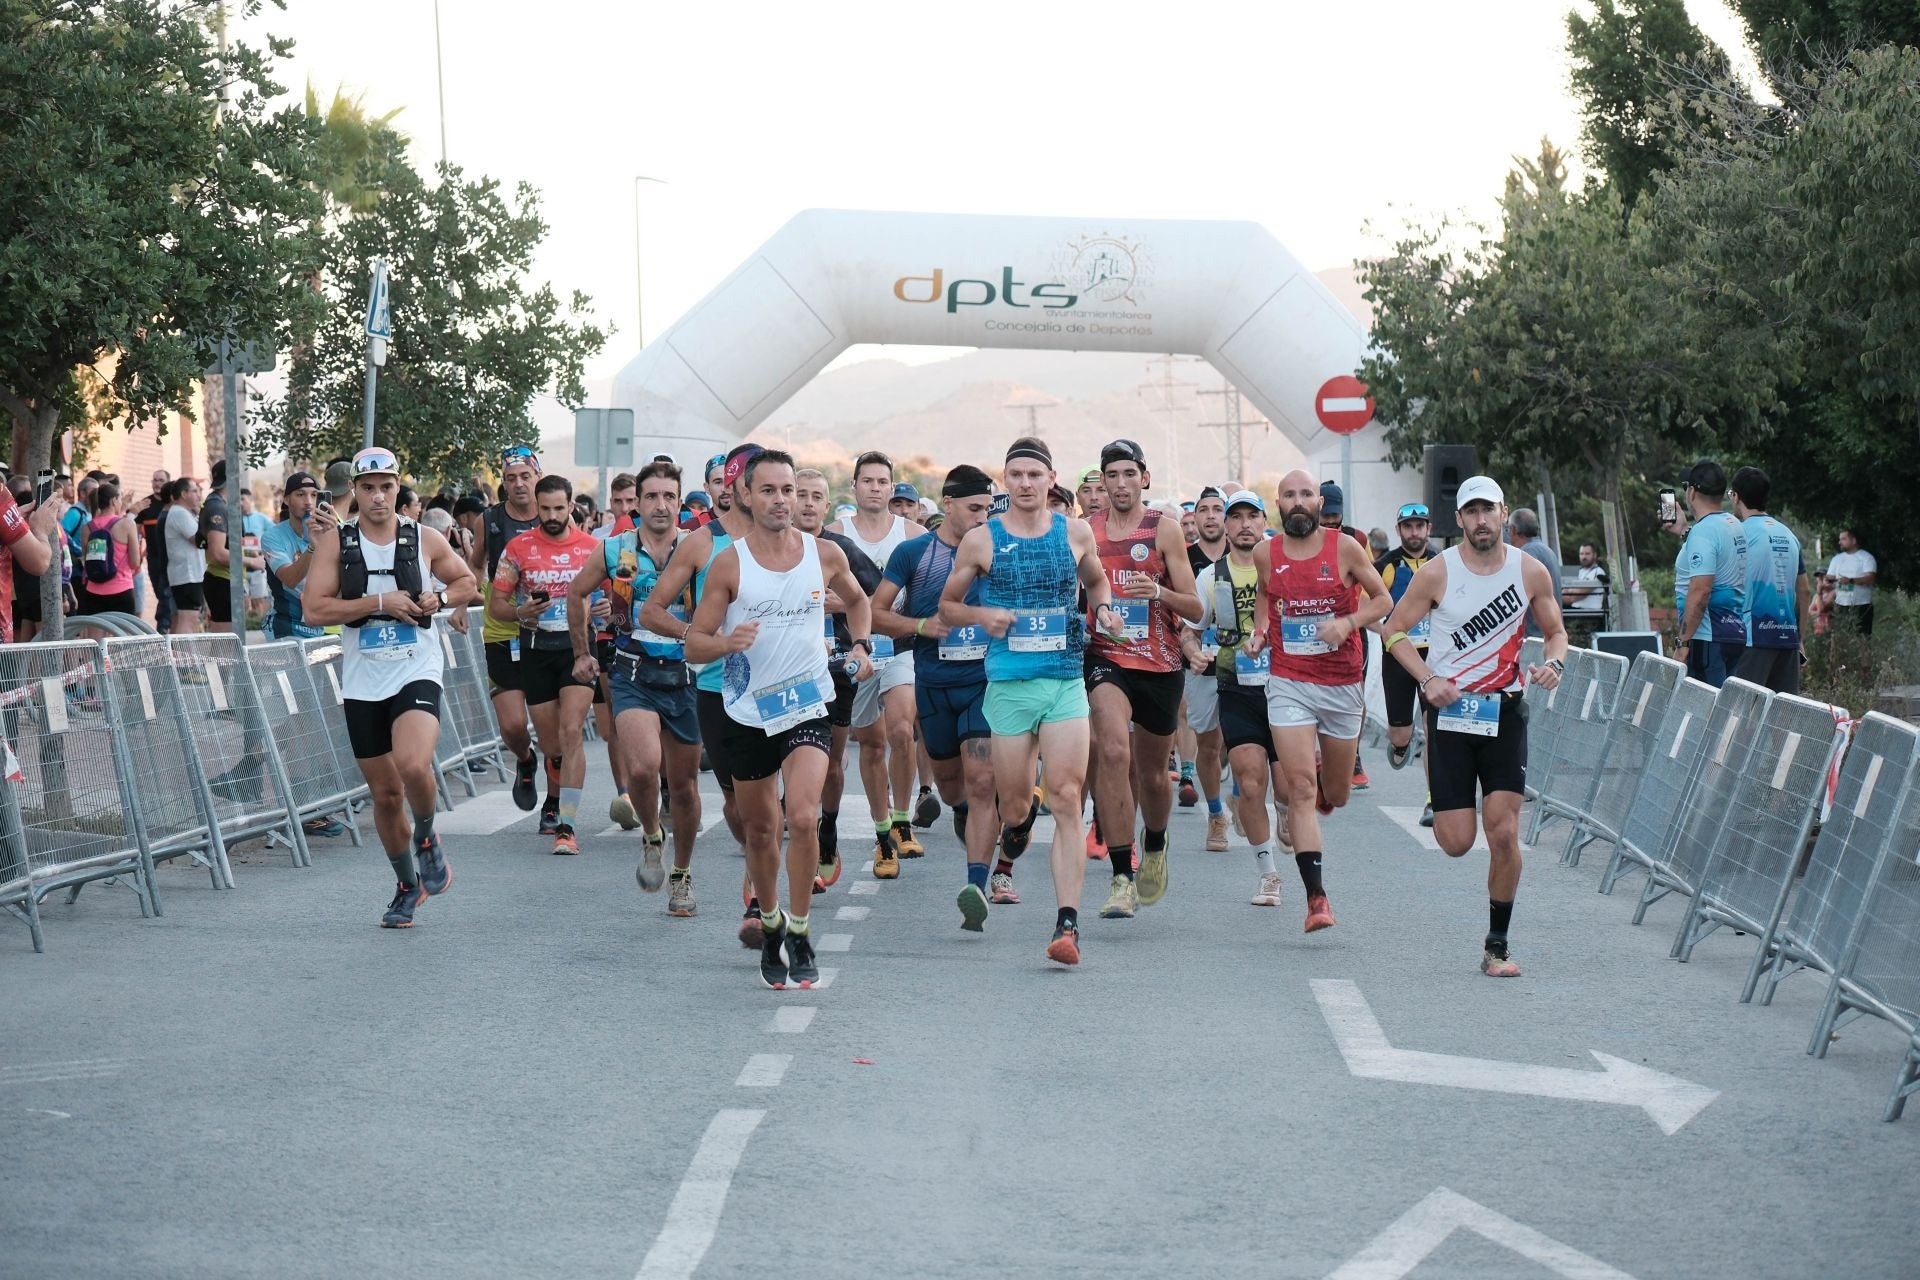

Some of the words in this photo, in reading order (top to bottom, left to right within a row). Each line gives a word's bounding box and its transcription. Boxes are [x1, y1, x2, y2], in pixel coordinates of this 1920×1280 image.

[893, 266, 1078, 313] dpts
[1065, 323, 1086, 334] de
[1089, 324, 1153, 336] Deportes
[525, 568, 583, 583] MARAT
[1289, 598, 1336, 608] PUERTAS
[1295, 606, 1332, 615] LORCA
[1462, 583, 1523, 643] PROJECT
[1029, 616, 1047, 631] 35
[1299, 623, 1317, 637] 69
[1418, 620, 1430, 631] 36
[378, 626, 397, 641] 45
[958, 626, 976, 641] 43
[777, 687, 799, 707] 74
[1460, 698, 1479, 714] 39
